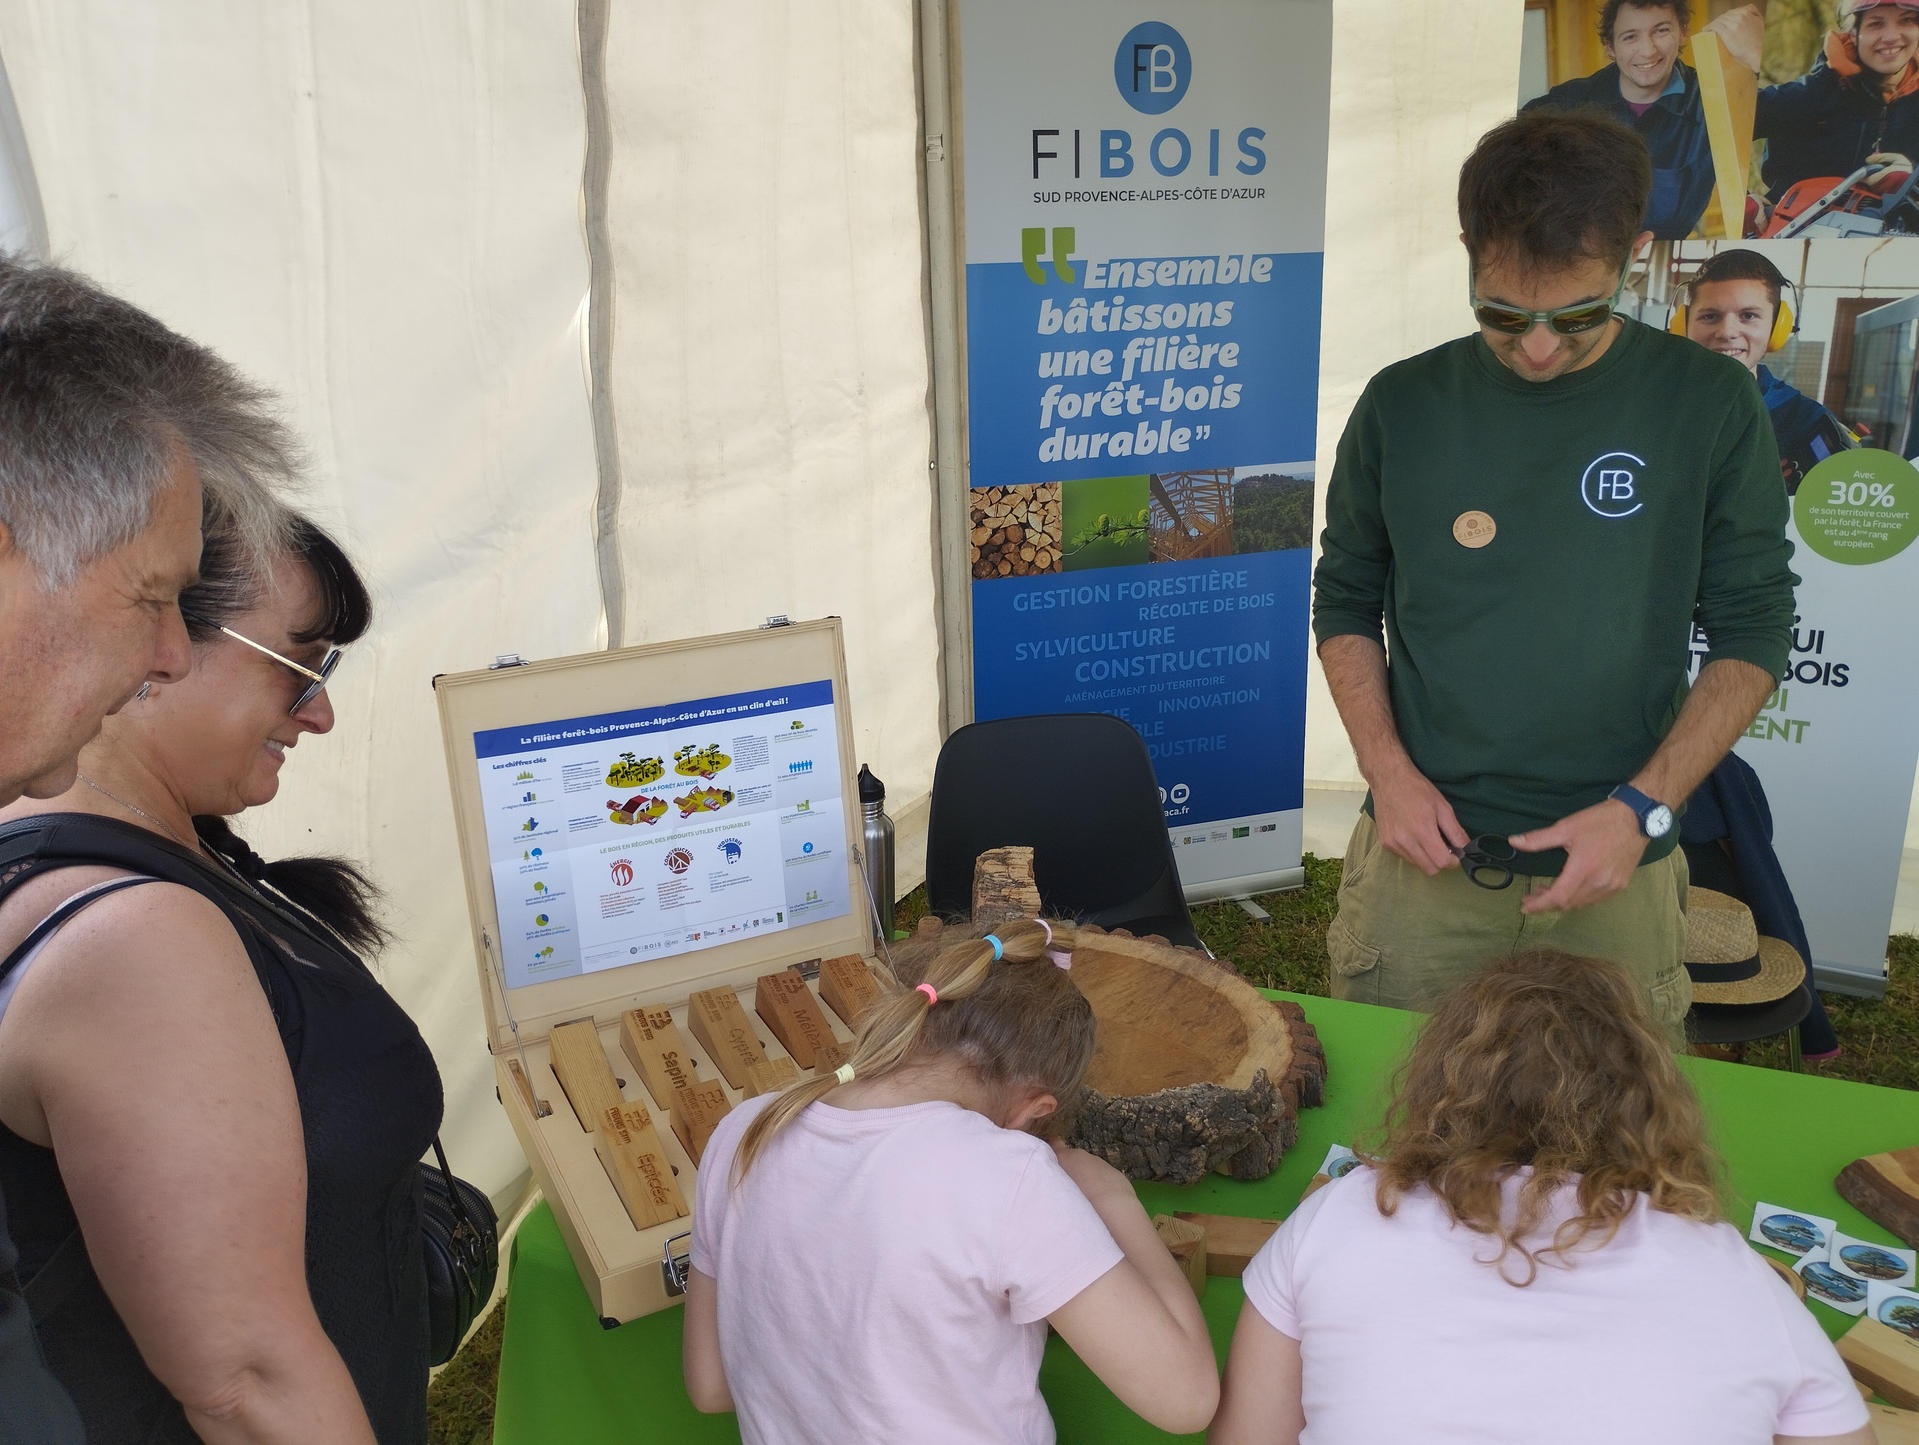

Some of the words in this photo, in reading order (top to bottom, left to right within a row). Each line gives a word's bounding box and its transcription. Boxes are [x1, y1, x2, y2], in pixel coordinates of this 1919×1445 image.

[1032, 127, 1267, 179] FIBOIS
[1033, 191, 1061, 203] SUD
[1065, 187, 1217, 203] PROVENCE-ALPES-CÔTE
[1221, 188, 1265, 200] D'AZUR
[1037, 296, 1234, 336] bâtissons
[1038, 348, 1113, 379] une
[1122, 333, 1240, 382] filière
[1040, 374, 1243, 430] forêt-bois
[1853, 470, 1876, 480] Avec
[1827, 481, 1895, 508] 30%
[1808, 506, 1819, 514] de
[1820, 507, 1836, 516] son
[1837, 508, 1875, 518] territoire
[1876, 511, 1910, 520] couvert
[1814, 518, 1828, 526] par
[1829, 517, 1838, 526] la
[1863, 519, 1871, 528] la
[1872, 520, 1902, 529] France
[1824, 528, 1838, 536] est
[1868, 531, 1889, 541] rang
[1833, 539, 1874, 549] européen.
[1013, 584, 1111, 612] GESTION
[1118, 569, 1248, 601] FORESTIÈRE
[1139, 600, 1209, 622] RÉCOLTE
[1213, 597, 1234, 613] DE
[1238, 593, 1275, 609] BOIS
[1015, 626, 1175, 661] SYLVICULTURE
[1075, 640, 1271, 683] CONSTRUCTION
[1150, 682, 1164, 694] DU
[1167, 675, 1225, 691] TERRITOIRE
[1158, 688, 1260, 714] INNOVATION
[533, 732, 561, 743] filière
[562, 725, 609, 739] forêt-bois
[610, 711, 698, 732] Provence-Alpes-Côte
[699, 706, 726, 718] d'Azur
[749, 700, 764, 710] clin
[492, 762, 505, 770] Les
[505, 758, 532, 769] chiffres
[533, 756, 547, 765] clés
[649, 785, 657, 793] LA
[677, 781, 685, 789] AU
[685, 779, 699, 787] BOIS
[1164, 805, 1190, 817] aca.fr
[717, 837, 743, 850] INDUSTRIE
[664, 846, 695, 866] CONSTRUCTION
[662, 1051, 687, 1089] Sapin
